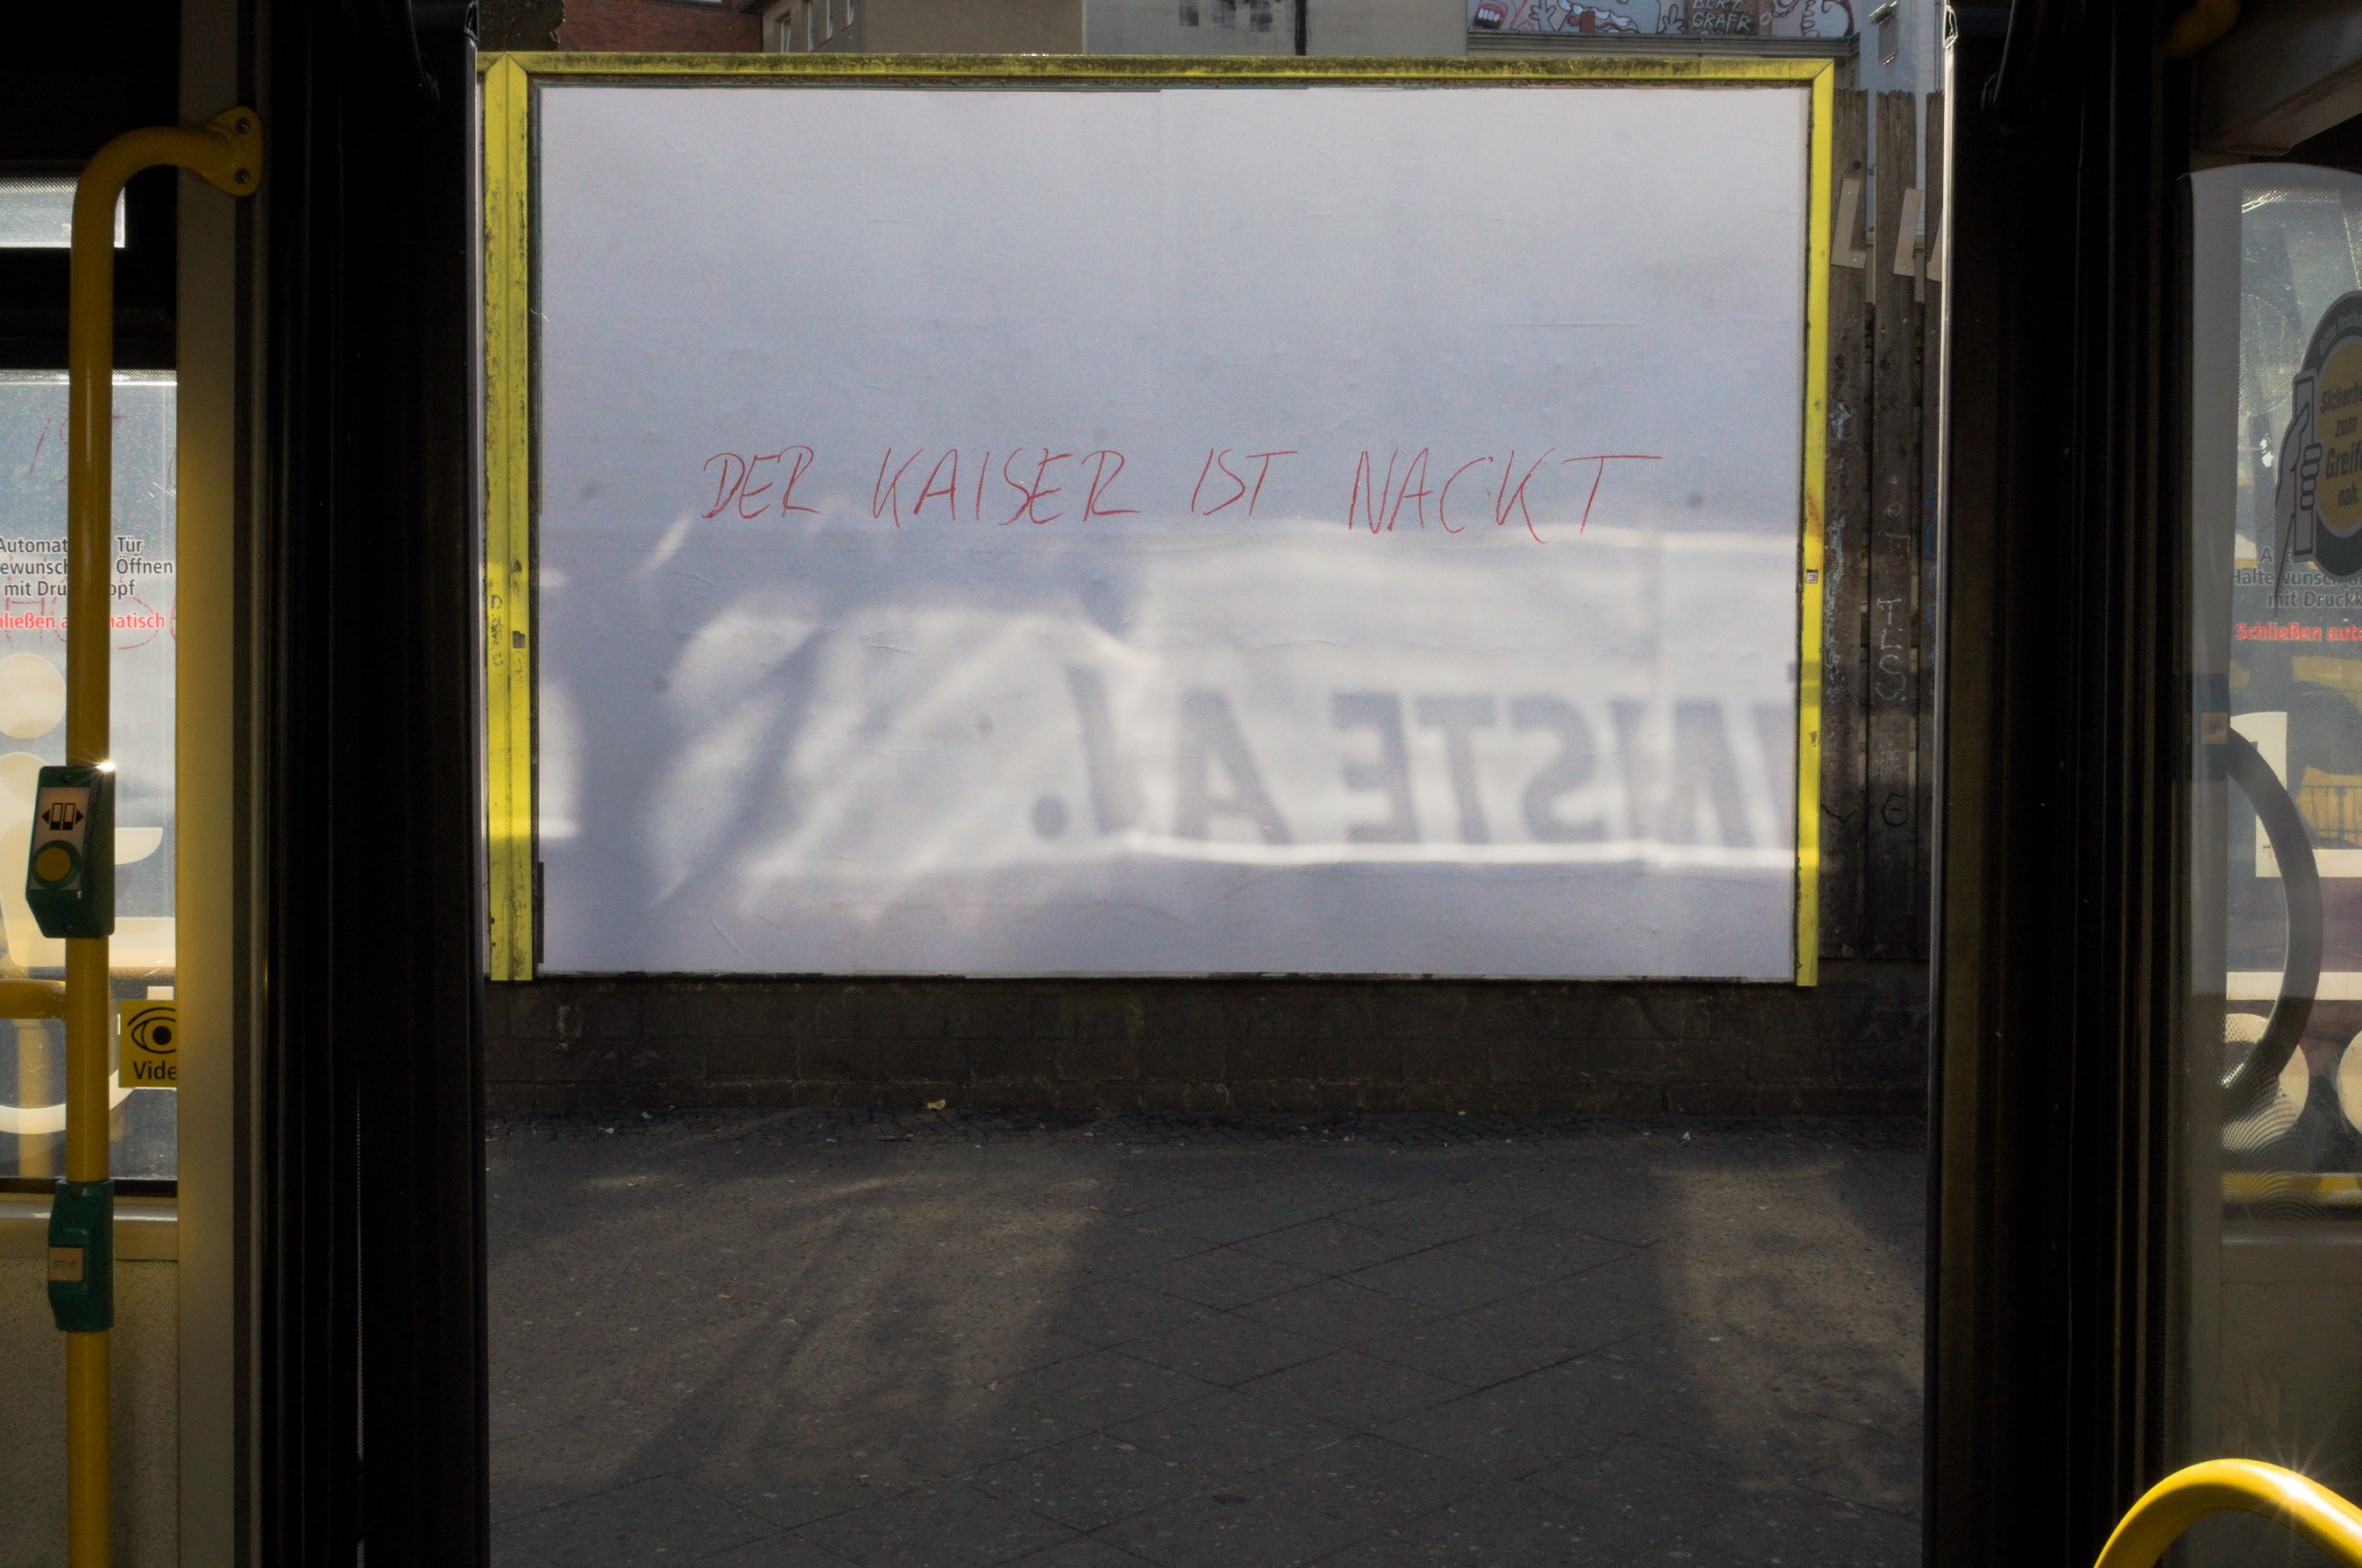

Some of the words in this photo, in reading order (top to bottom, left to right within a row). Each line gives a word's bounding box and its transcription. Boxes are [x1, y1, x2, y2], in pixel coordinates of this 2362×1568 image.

[701, 445, 820, 519] DER
[873, 447, 1139, 528] KAISER
[1191, 448, 1298, 516] IST
[1349, 447, 1663, 543] NACKT
[117, 536, 143, 552] Tür
[117, 556, 173, 574] Öffnen
[4, 580, 32, 596] mit
[2267, 590, 2298, 607] mit
[2237, 622, 2323, 641] Schließen
[132, 1060, 177, 1081] Vide
